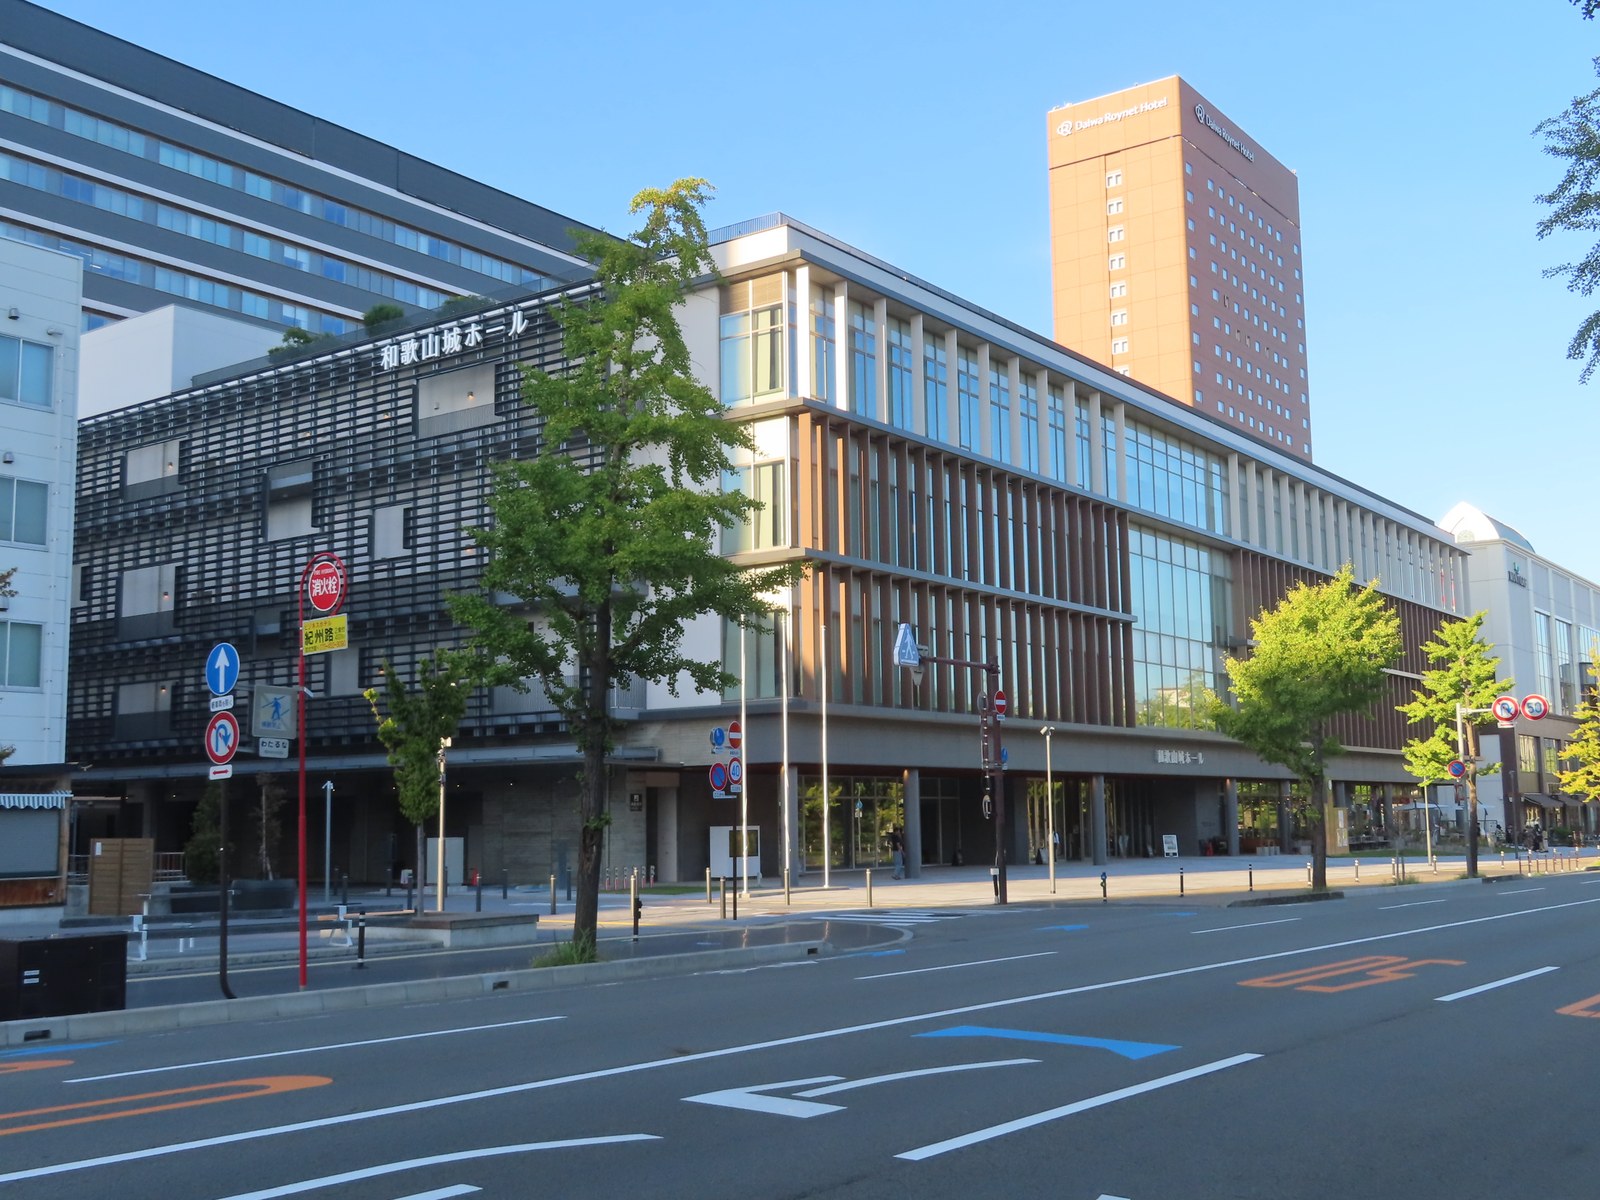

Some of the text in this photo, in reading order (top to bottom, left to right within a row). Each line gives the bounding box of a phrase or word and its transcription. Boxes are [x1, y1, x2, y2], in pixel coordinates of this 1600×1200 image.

[1075, 97, 1168, 131] Daiwa Roynet Hotel
[1206, 114, 1255, 162] Daiwa Roynet Hotel
[381, 311, 529, 370] 和歌山城ホール
[312, 576, 338, 597] 消火栓
[304, 627, 334, 646] 紀州路
[1526, 701, 1542, 714] 50
[261, 740, 288, 749] わたるな
[731, 765, 740, 777] 40
